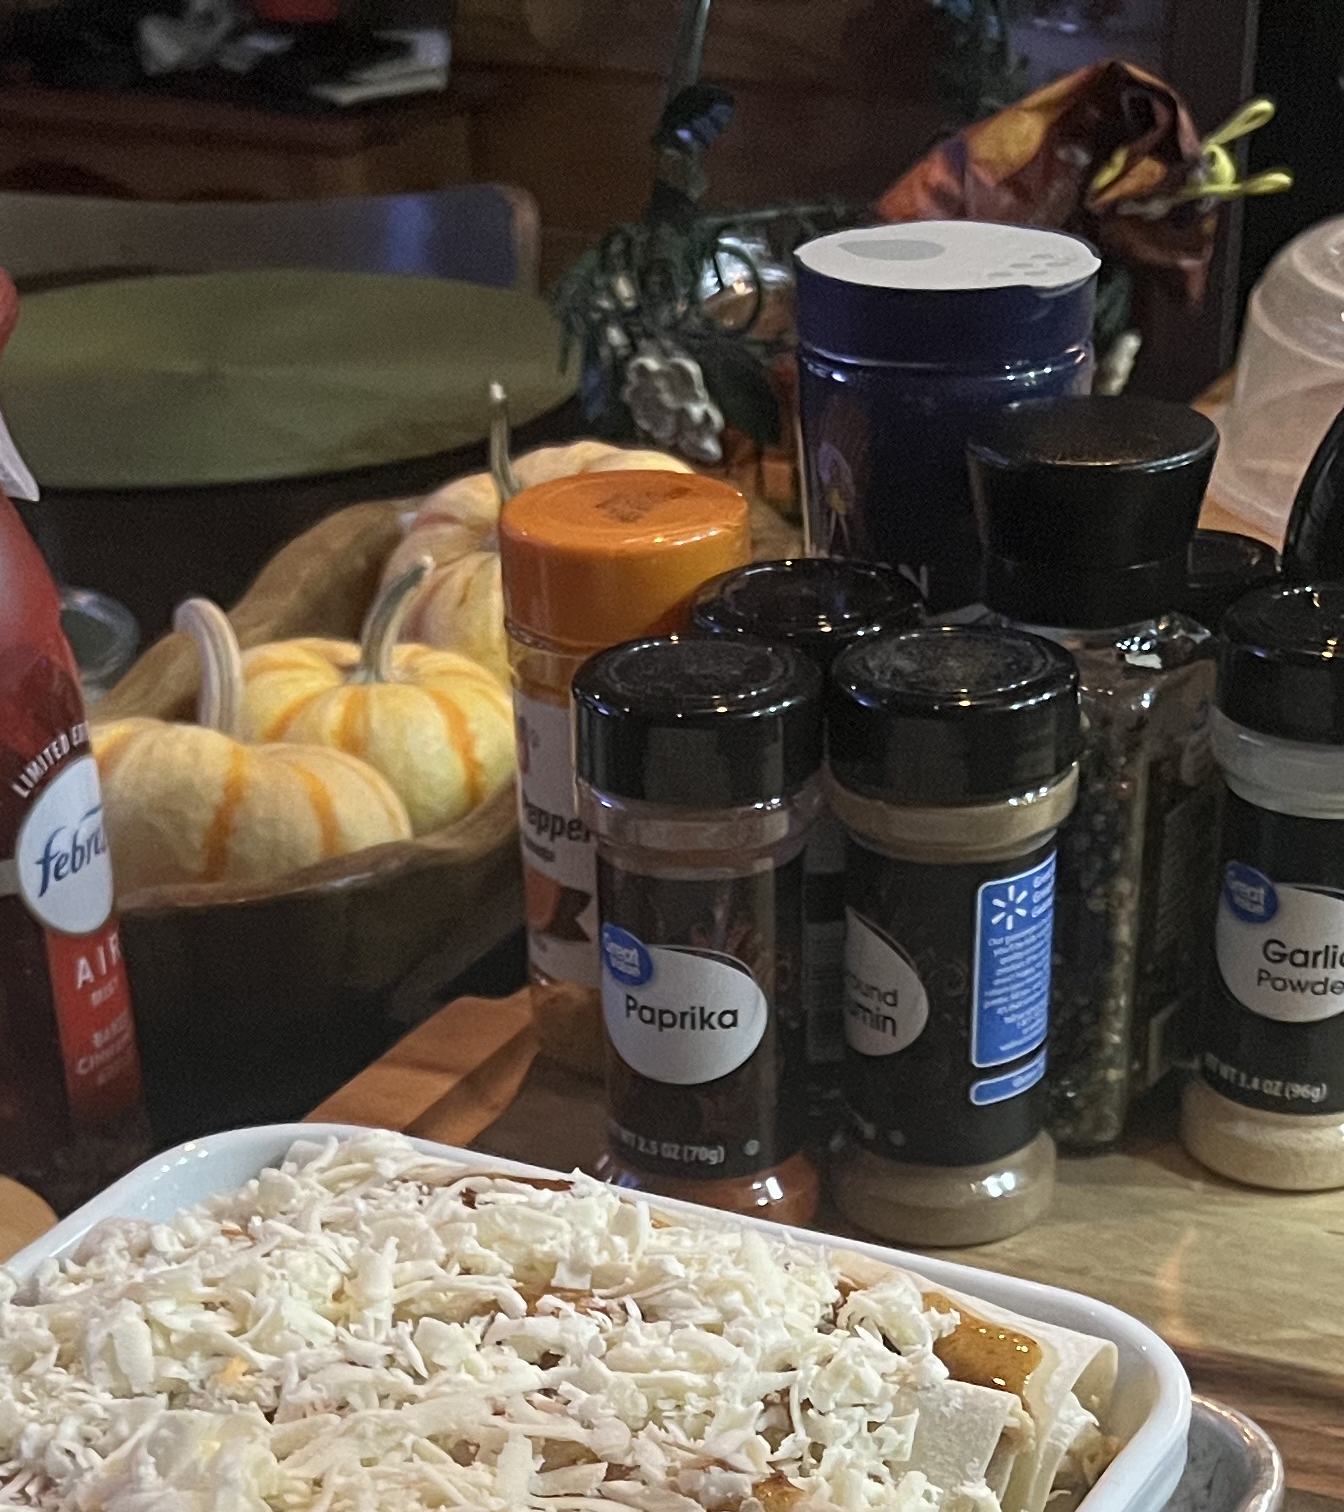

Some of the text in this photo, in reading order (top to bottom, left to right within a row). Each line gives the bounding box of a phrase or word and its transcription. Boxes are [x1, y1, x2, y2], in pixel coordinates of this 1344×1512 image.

[11, 732, 71, 799] LIMITED
[522, 790, 596, 843] epper
[625, 993, 739, 1033] Paprika
[1285, 1082, 1327, 1103] (96g)
[683, 1144, 725, 1165] (70g)
